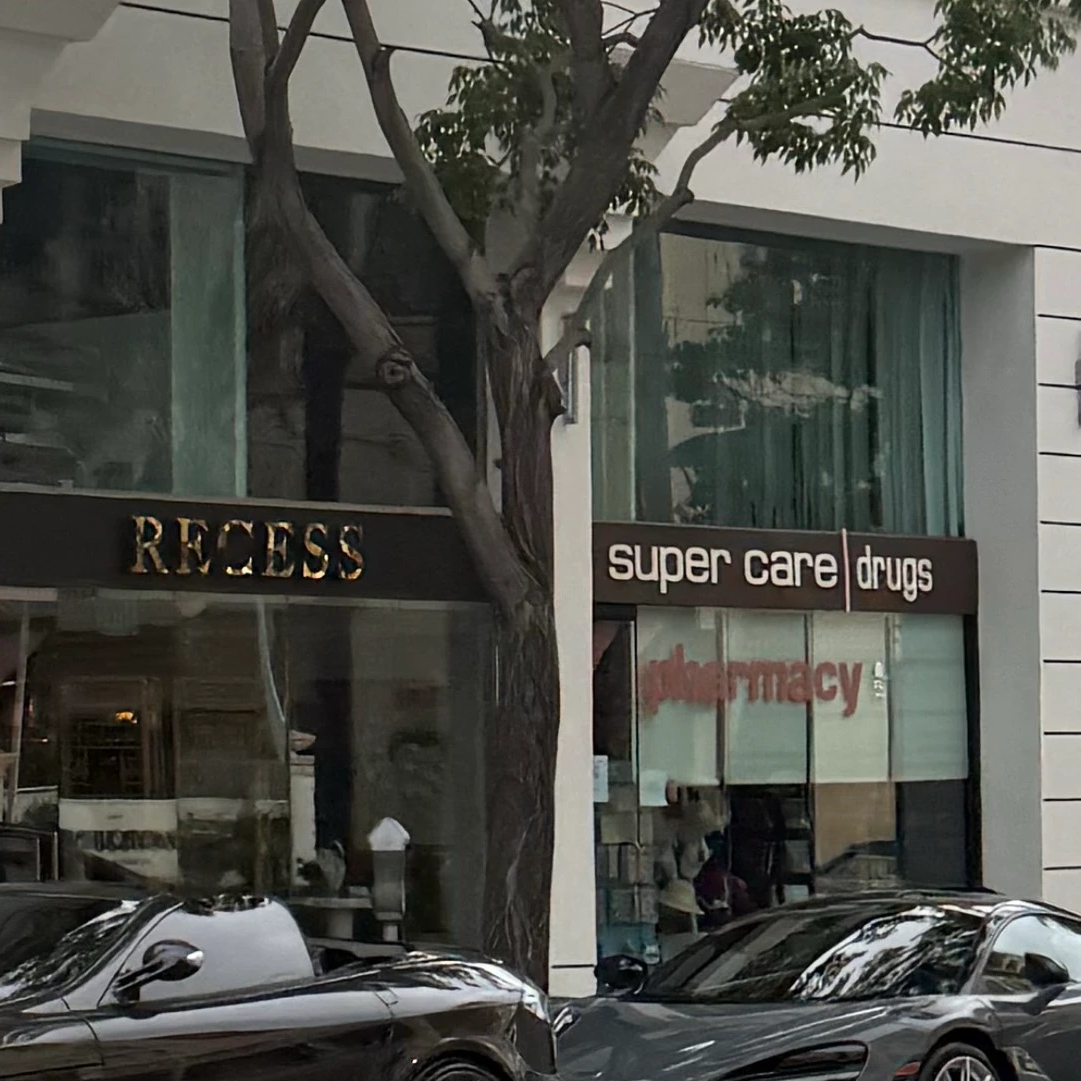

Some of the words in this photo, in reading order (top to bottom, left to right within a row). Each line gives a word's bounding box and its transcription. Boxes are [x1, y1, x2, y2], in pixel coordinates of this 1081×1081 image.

[129, 515, 369, 580] RECESS
[609, 544, 731, 594] super
[744, 549, 838, 588] care
[857, 544, 933, 602] drugs
[642, 643, 863, 718] pharmacy
